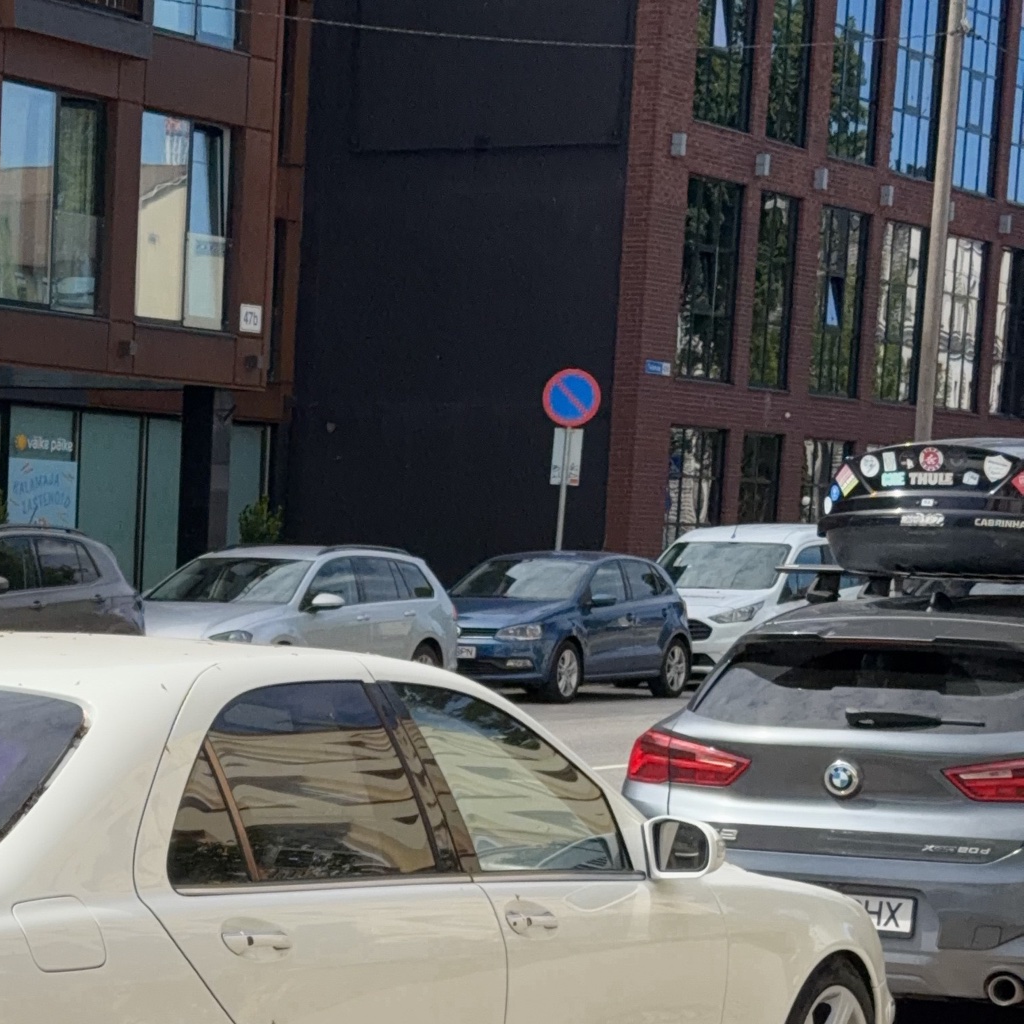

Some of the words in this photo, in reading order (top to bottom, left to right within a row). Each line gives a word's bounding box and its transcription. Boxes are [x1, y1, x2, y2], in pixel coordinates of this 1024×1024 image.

[243, 311, 259, 326] 47b
[908, 472, 954, 486] THULE
[974, 518, 1024, 528] CABRINHA
[856, 899, 903, 928] HX
